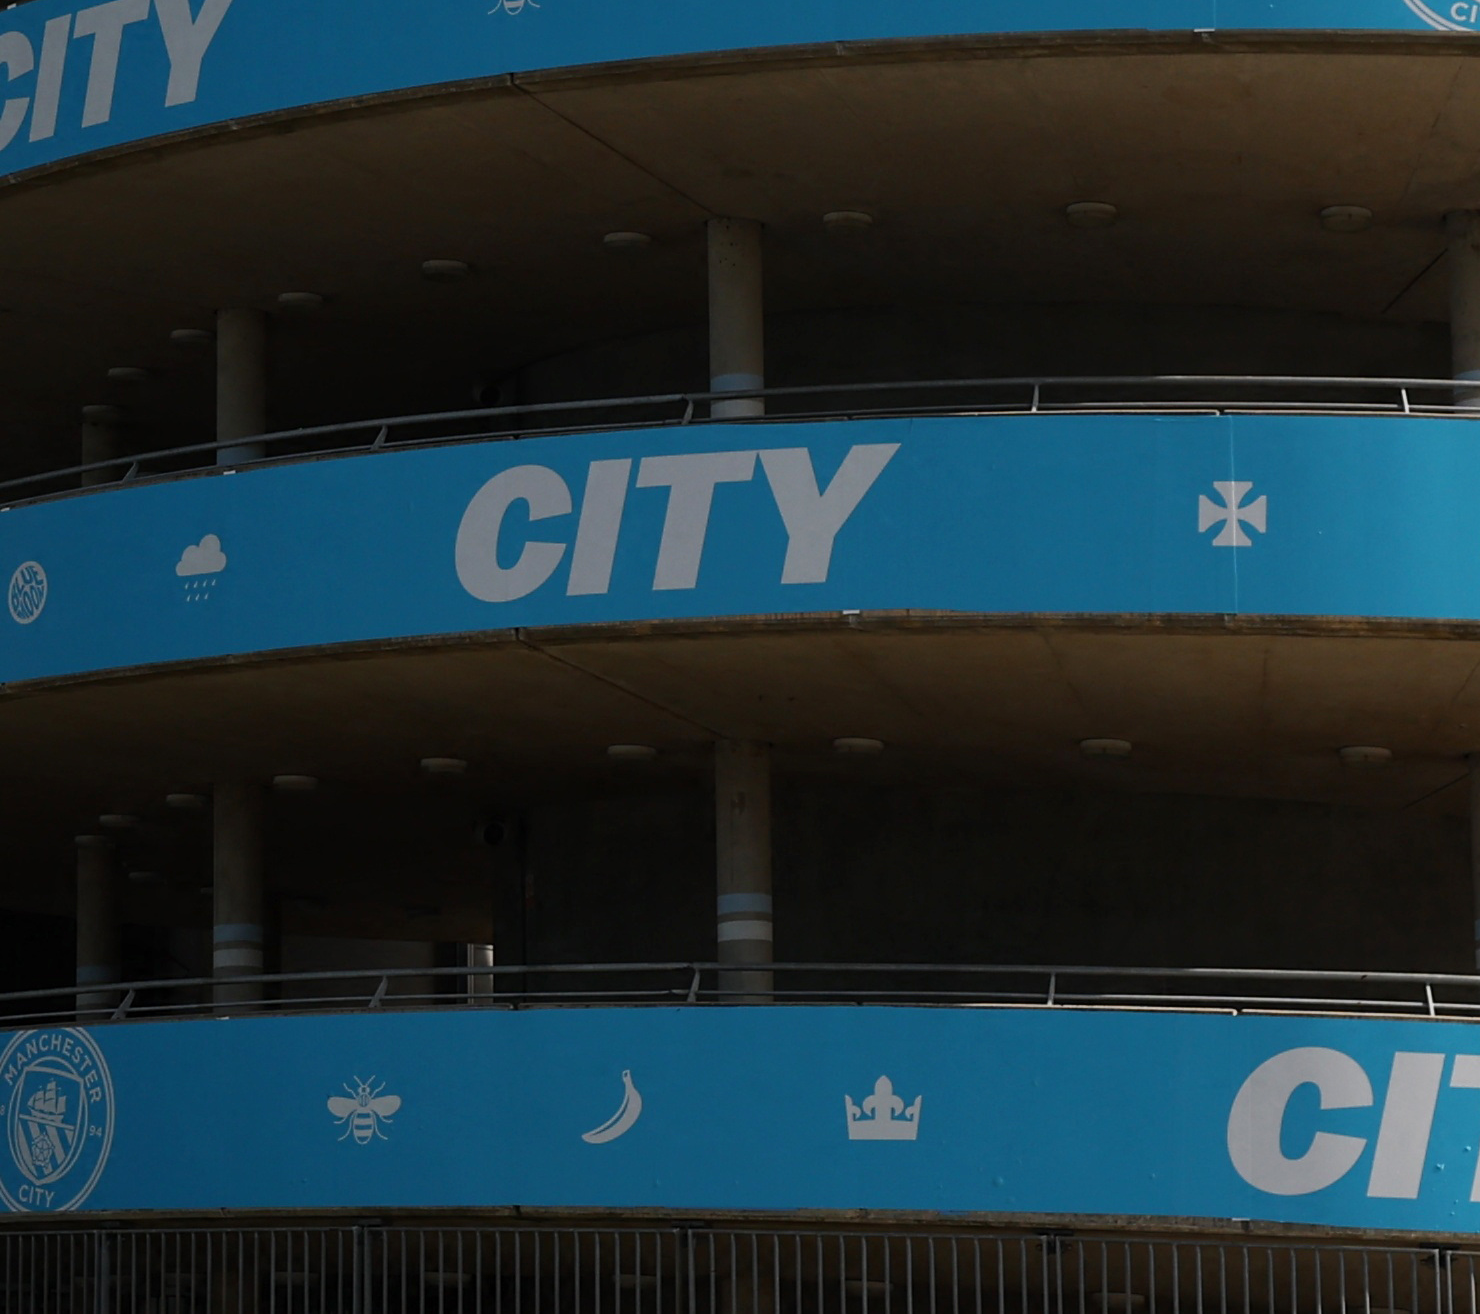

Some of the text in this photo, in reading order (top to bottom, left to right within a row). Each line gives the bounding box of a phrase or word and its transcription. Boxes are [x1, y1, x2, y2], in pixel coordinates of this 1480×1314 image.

[454, 443, 903, 603] CITY
[11, 566, 44, 613] BLUE
[16, 584, 45, 619] MOON
[4, 1034, 102, 1104] MANCHESTER
[89, 1125, 103, 1137] 94
[18, 1185, 56, 1208] CITY
